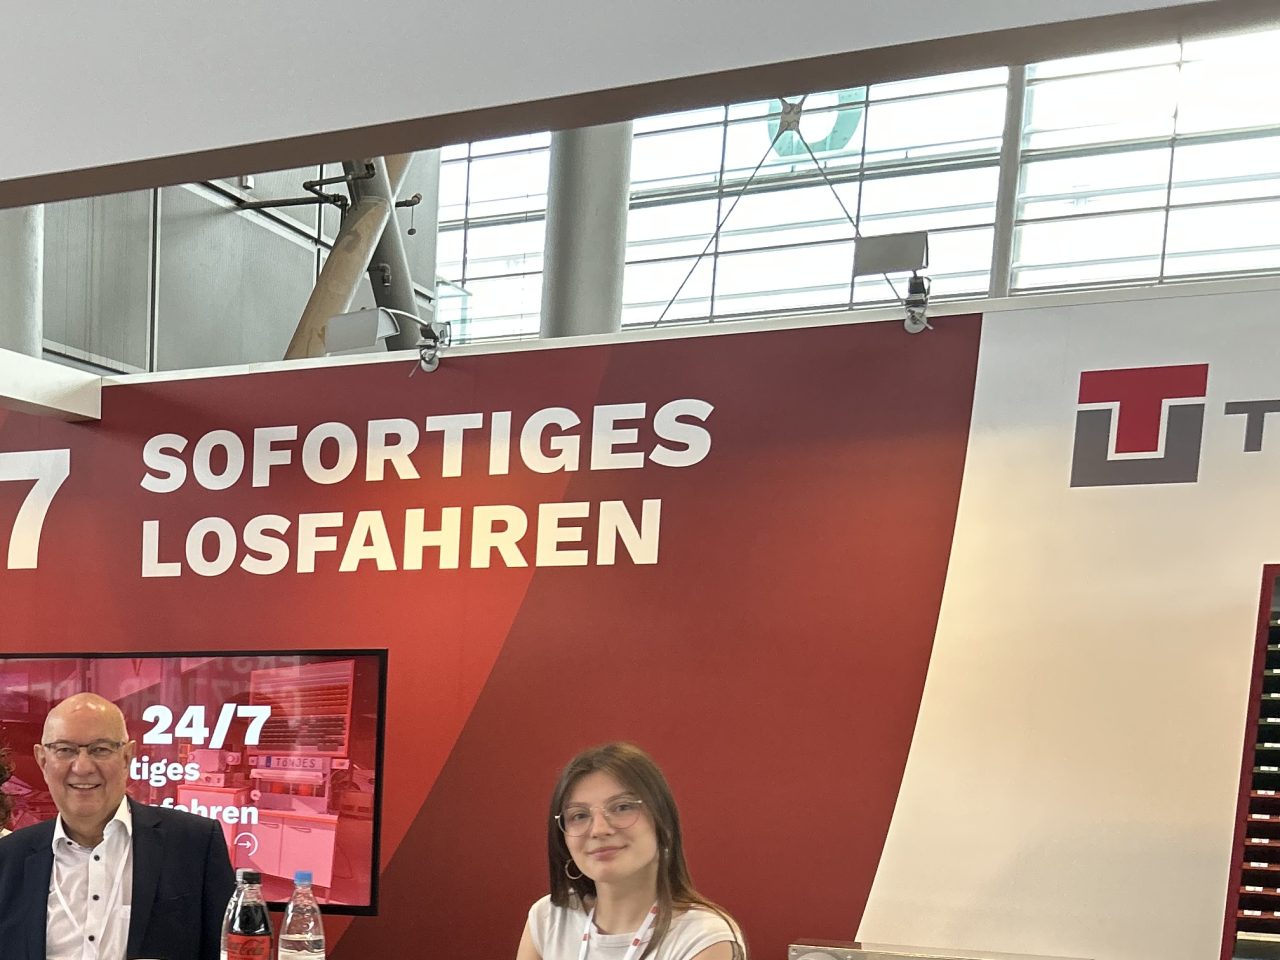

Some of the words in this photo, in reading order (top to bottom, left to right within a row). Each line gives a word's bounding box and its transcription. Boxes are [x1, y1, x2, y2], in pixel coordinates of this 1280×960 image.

[139, 397, 714, 494] SOFORTIGES
[141, 497, 663, 579] LOSFAHREN
[141, 702, 272, 749] 24/7
